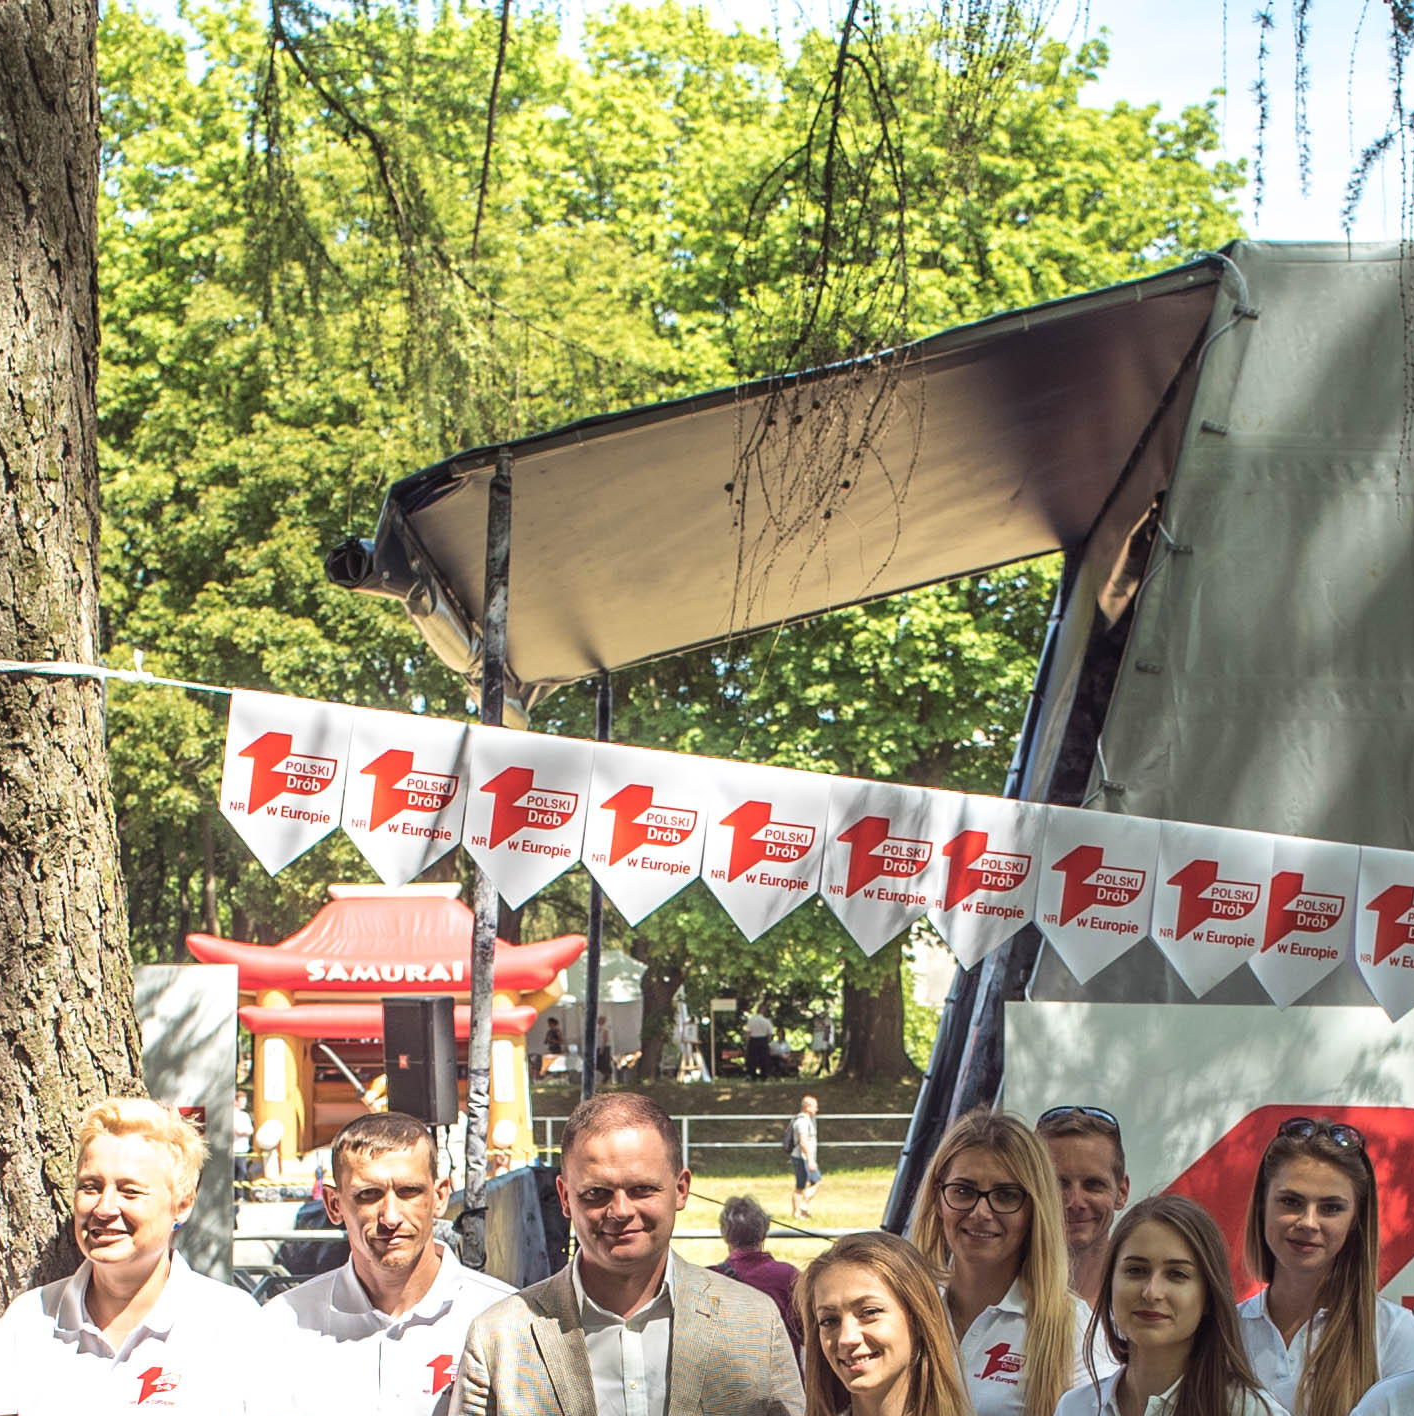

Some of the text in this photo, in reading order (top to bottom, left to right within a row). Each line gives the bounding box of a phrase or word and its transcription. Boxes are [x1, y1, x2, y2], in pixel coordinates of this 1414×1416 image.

[285, 760, 330, 776] POLSKI
[286, 774, 321, 792] Drób
[406, 778, 452, 796] POLSKI
[229, 800, 245, 811] NR
[407, 791, 443, 808] Drób
[526, 794, 570, 810] POLSKI
[266, 805, 330, 823] w Europie
[527, 809, 562, 826] Drób
[646, 812, 690, 827] POLSKI
[388, 822, 452, 841] w Europie
[470, 834, 487, 846] NR
[646, 826, 682, 843] Drób
[764, 828, 808, 844] POLSKI
[507, 840, 571, 859] w Europie
[765, 842, 800, 859] Drób
[881, 843, 925, 859] POLSKI
[627, 857, 690, 876] w Europie
[710, 868, 725, 879] NR
[883, 857, 916, 874] Drób
[981, 858, 1025, 875] POLSKI
[745, 873, 809, 891] w Europie
[981, 871, 1013, 887] Drób
[1095, 872, 1138, 888] POLSKI
[828, 884, 844, 895] NR
[863, 888, 926, 905] w Europie
[1096, 886, 1131, 903] Drób
[1210, 886, 1253, 901] POLSKI
[960, 902, 1025, 920] w Europie
[1212, 900, 1245, 916] Drób
[1295, 898, 1338, 914] POLSKI
[1076, 917, 1138, 935] w Europie
[1296, 912, 1328, 929] Drób
[1192, 930, 1255, 948] w Europie
[1277, 943, 1338, 961] w Europie
[1388, 957, 1400, 966] w
[306, 959, 464, 982] SAMURAI
